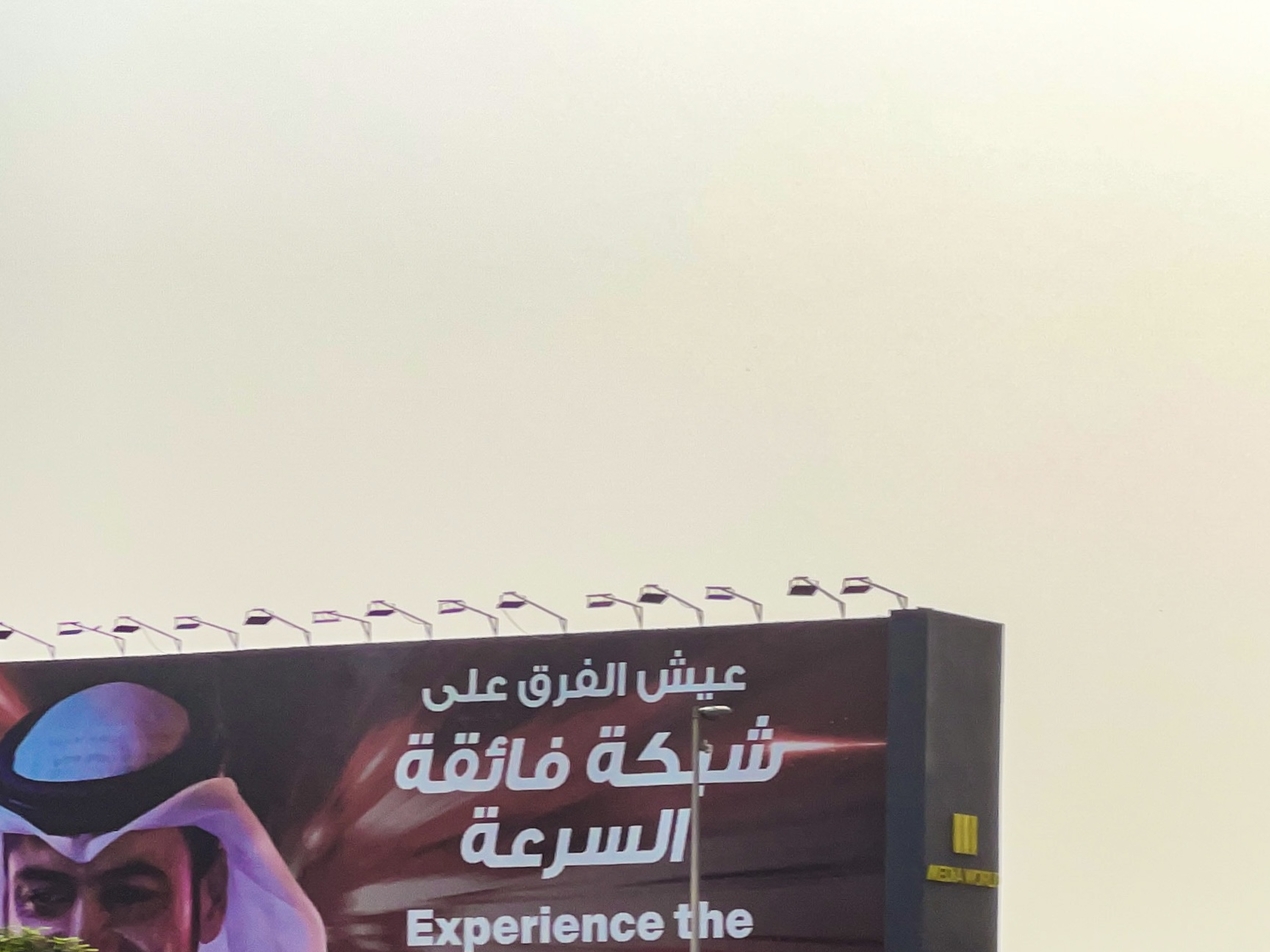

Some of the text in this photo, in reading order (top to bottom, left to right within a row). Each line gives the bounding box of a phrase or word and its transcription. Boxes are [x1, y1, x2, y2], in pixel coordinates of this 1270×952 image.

[422, 650, 747, 713] عيش الفرق على
[394, 715, 786, 797] شبكة فائقة
[460, 806, 692, 879] السرعة
[406, 901, 755, 952] Experience the
